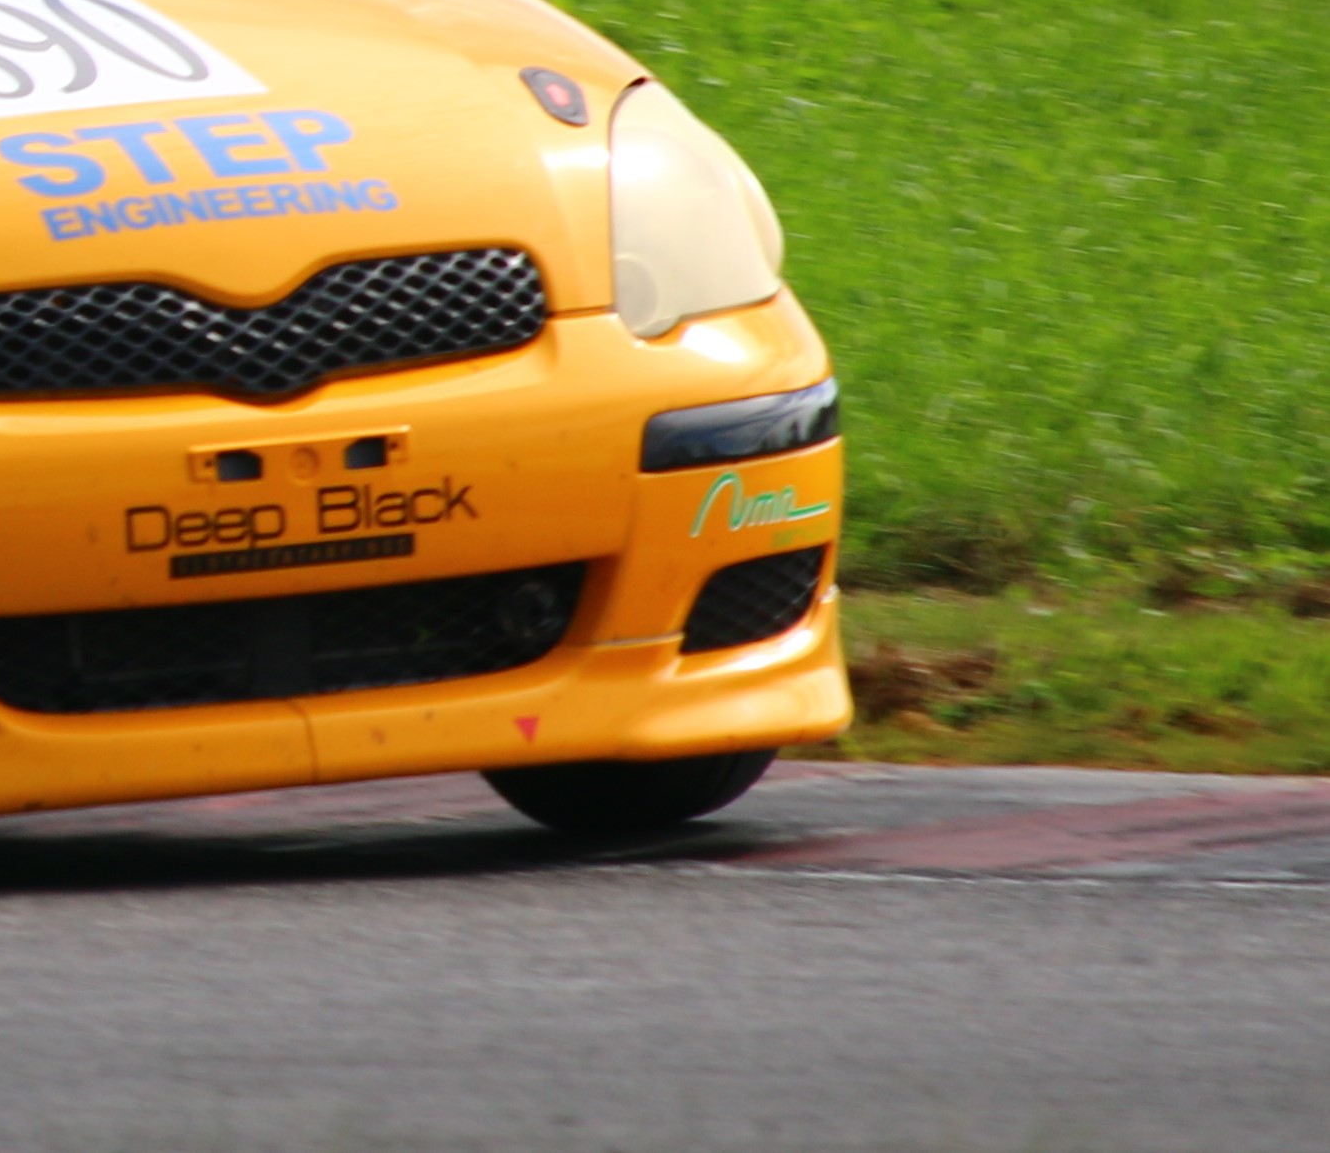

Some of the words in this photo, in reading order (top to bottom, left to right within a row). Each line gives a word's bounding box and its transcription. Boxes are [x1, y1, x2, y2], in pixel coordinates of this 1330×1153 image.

[40, 179, 399, 242] ENGINEERING
[125, 504, 286, 549] Deep
[316, 476, 479, 535] Black
